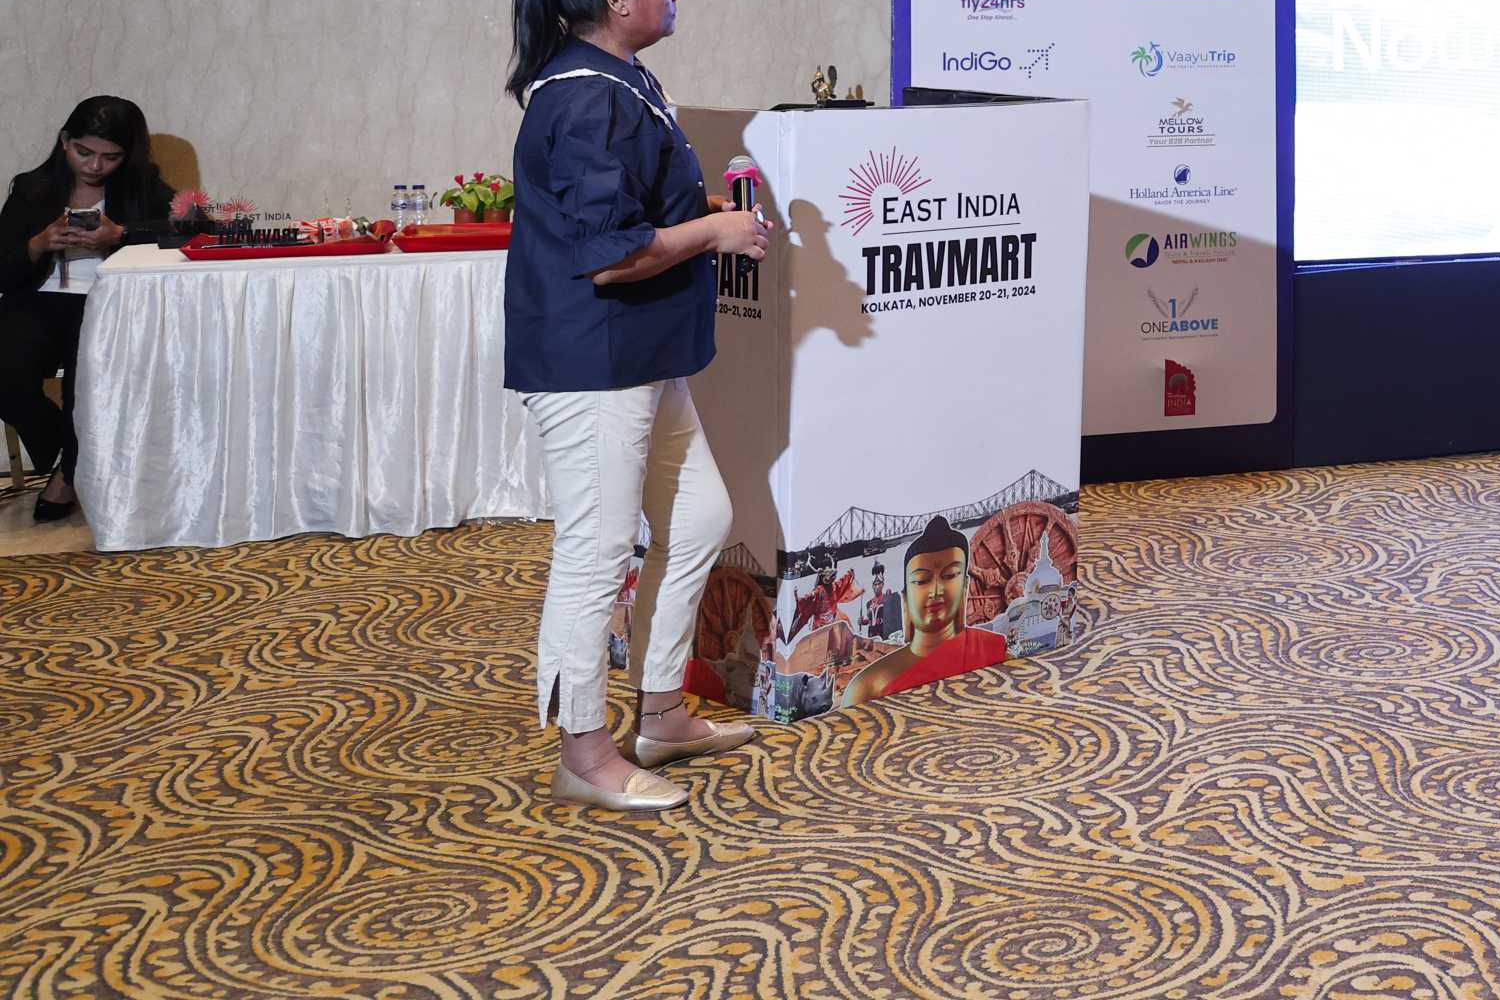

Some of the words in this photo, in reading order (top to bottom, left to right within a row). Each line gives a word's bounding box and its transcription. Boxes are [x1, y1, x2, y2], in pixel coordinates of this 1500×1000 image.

[942, 51, 1012, 72] IndiGo
[1168, 50, 1236, 64] VaayuTrip
[1158, 126, 1204, 134] TOURS
[1159, 118, 1204, 126] MELLOW
[1130, 188, 1168, 199] Holland
[1171, 187, 1210, 198] America
[882, 196, 947, 224] EAST
[956, 192, 1021, 219] INDIA
[1164, 232, 1236, 250] AIRWINGS
[862, 233, 1037, 296] TRAVMART
[861, 298, 916, 314] KOLKATA,
[918, 291, 977, 308] NOVEMBER
[979, 287, 1010, 302] 20-21,
[1012, 285, 1036, 298] 2024
[742, 306, 762, 319] 2024
